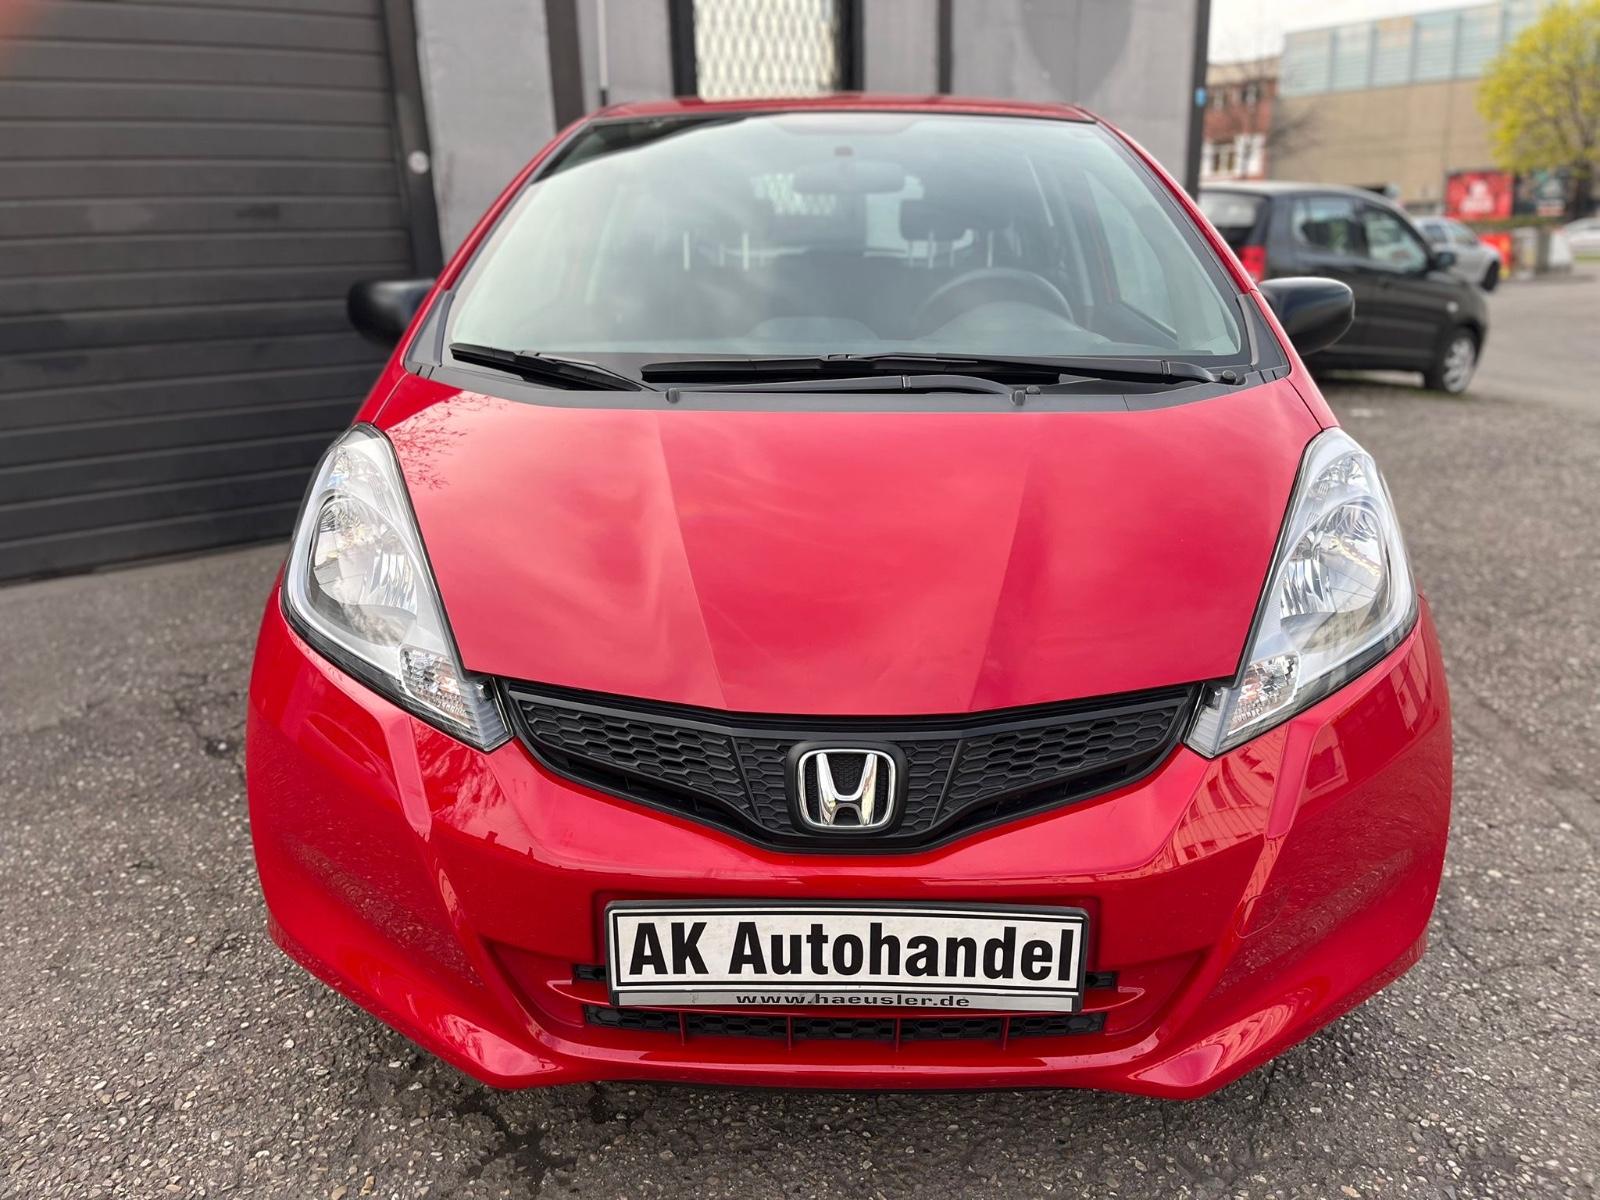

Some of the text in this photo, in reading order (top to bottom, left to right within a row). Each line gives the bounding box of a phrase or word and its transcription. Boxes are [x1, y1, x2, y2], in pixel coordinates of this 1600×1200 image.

[629, 921, 1075, 981] AK Autohandel
[736, 993, 970, 1007] www.haeusler.de
